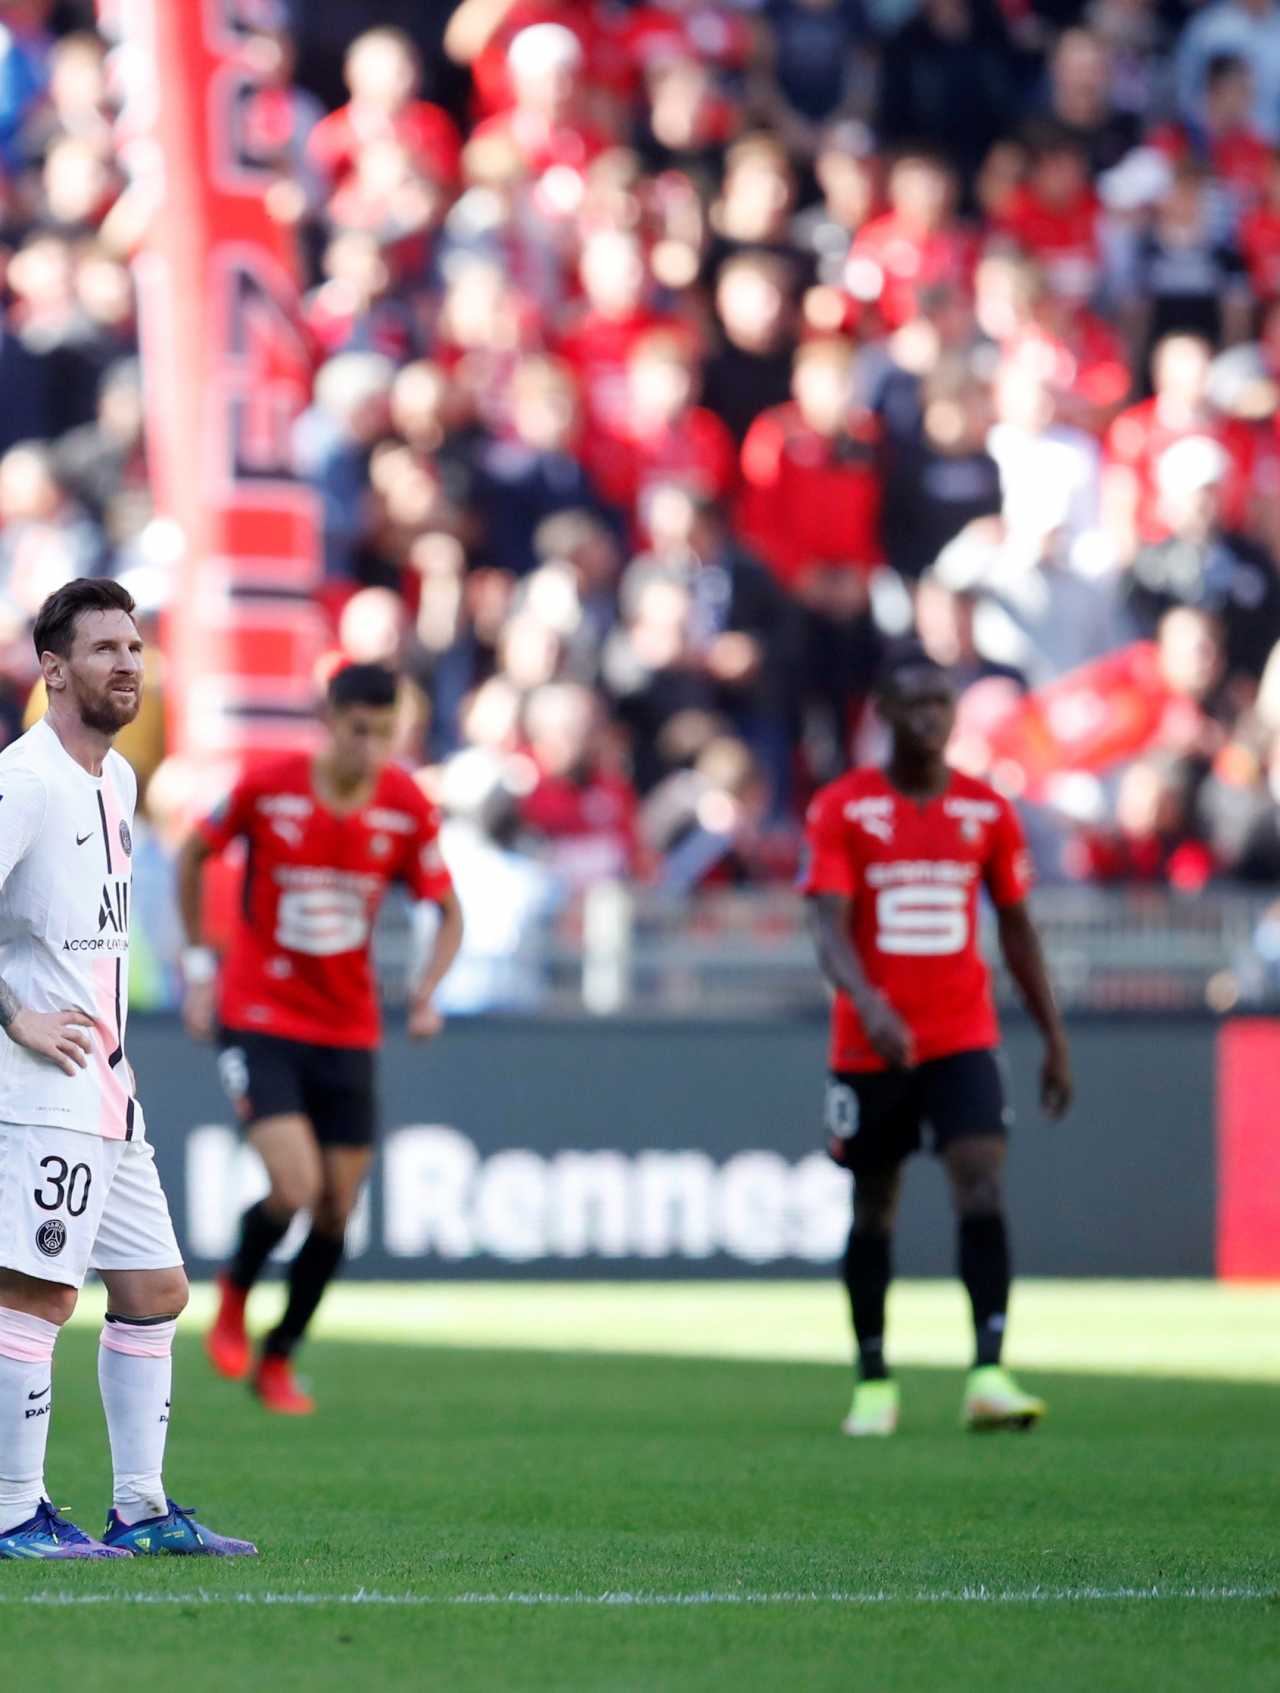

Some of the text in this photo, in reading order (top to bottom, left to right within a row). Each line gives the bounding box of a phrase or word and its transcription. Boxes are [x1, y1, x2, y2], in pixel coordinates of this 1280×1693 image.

[62, 938, 104, 951] ACCOR
[34, 1155, 91, 1217] 30
[381, 1124, 855, 1263] Rennes
